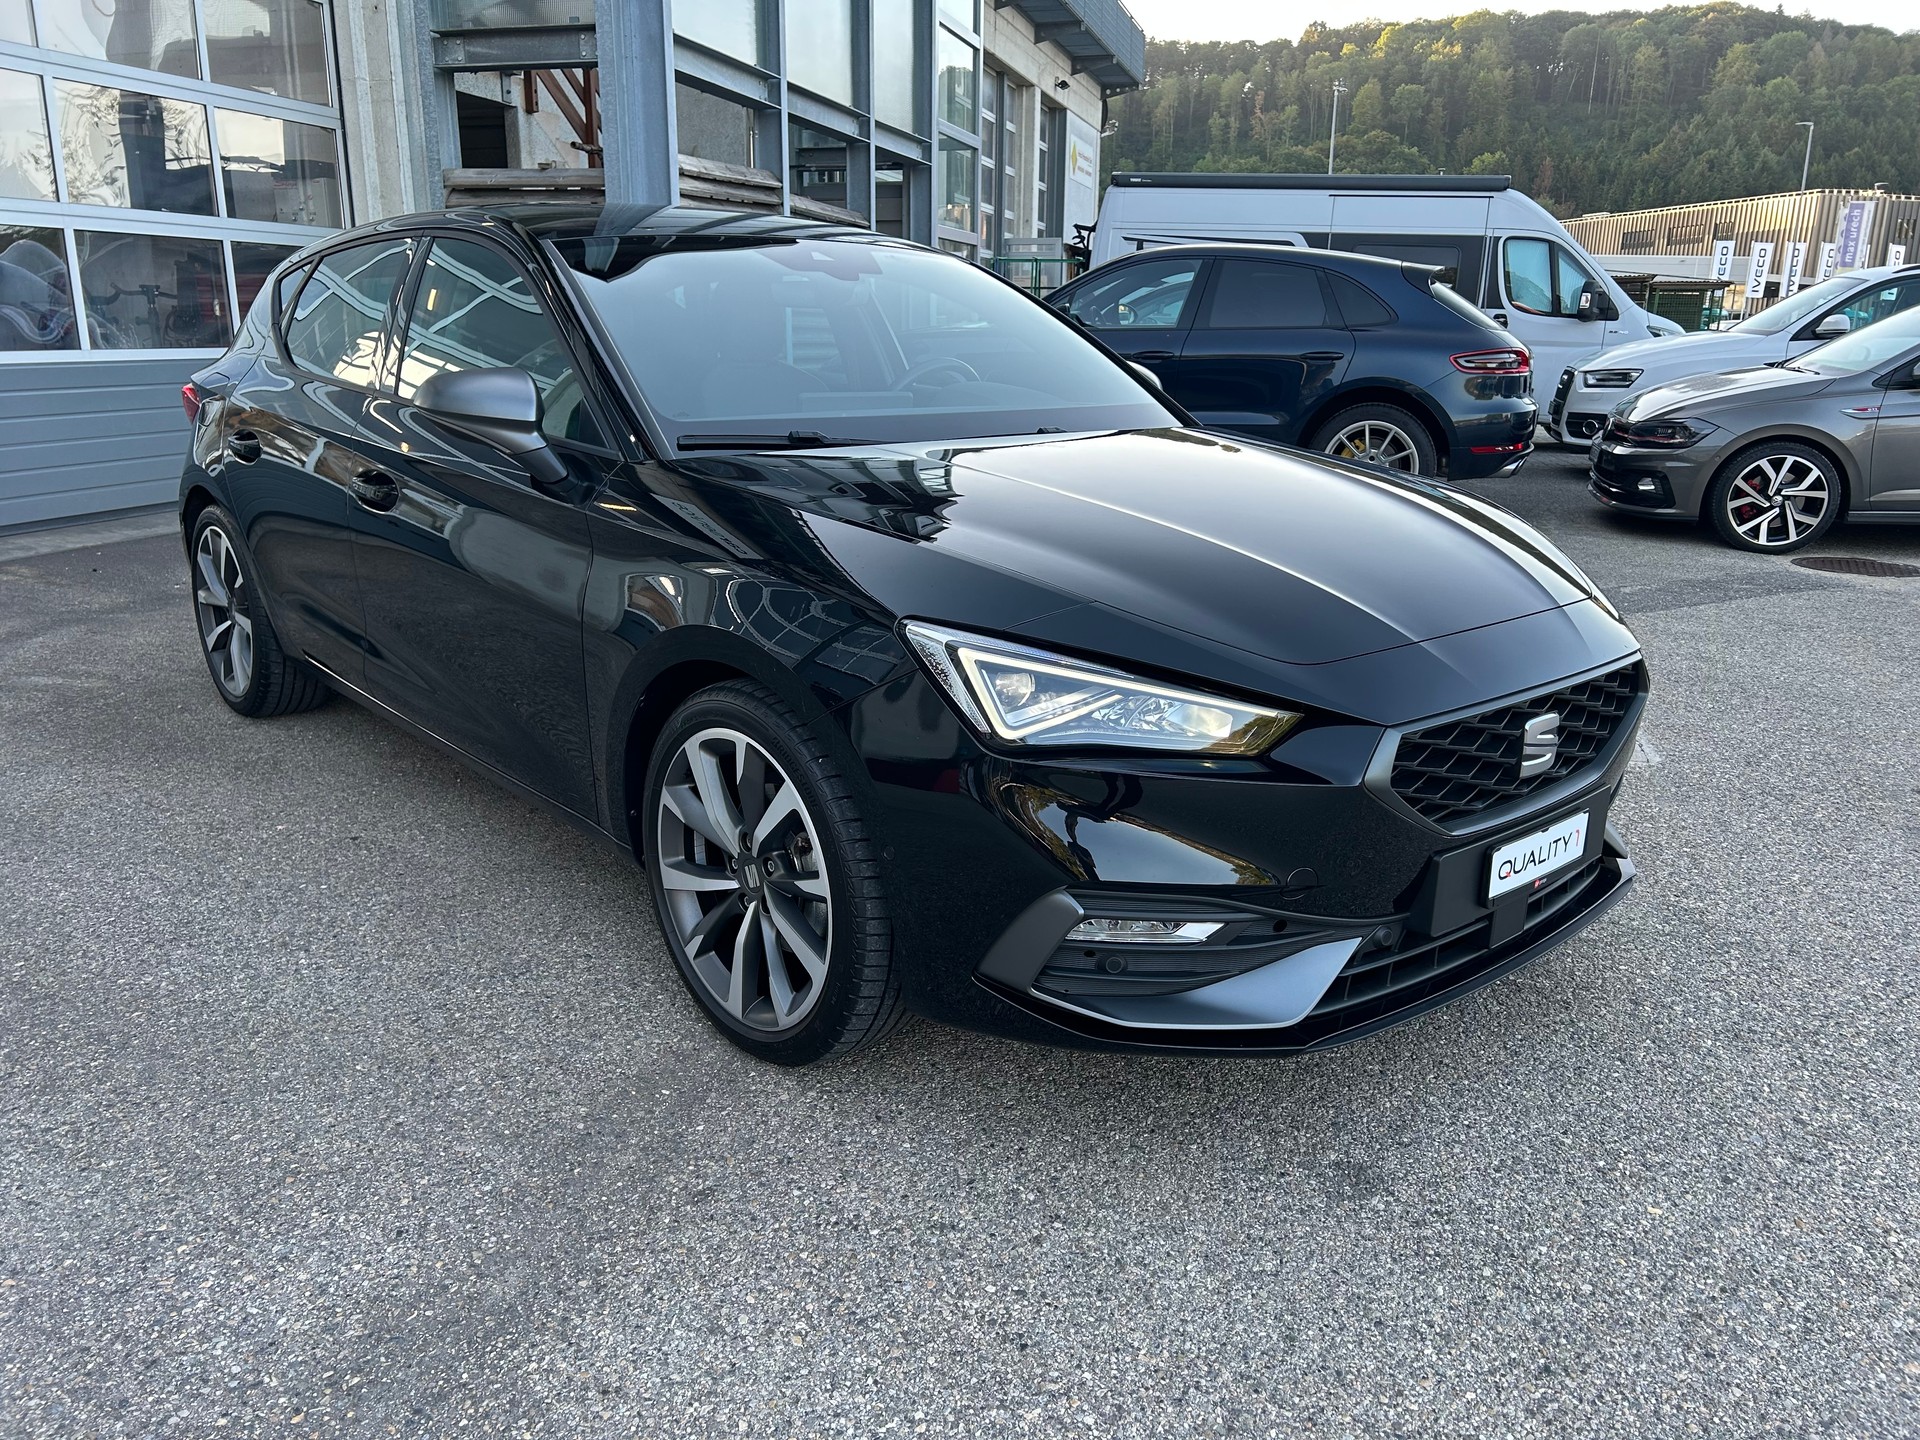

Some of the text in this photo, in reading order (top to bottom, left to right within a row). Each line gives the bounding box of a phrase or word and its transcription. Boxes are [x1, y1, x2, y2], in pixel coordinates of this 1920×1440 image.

[1845, 209, 1862, 262] max urech
[1717, 246, 1729, 281] ECO
[1751, 248, 1767, 293] IVECO
